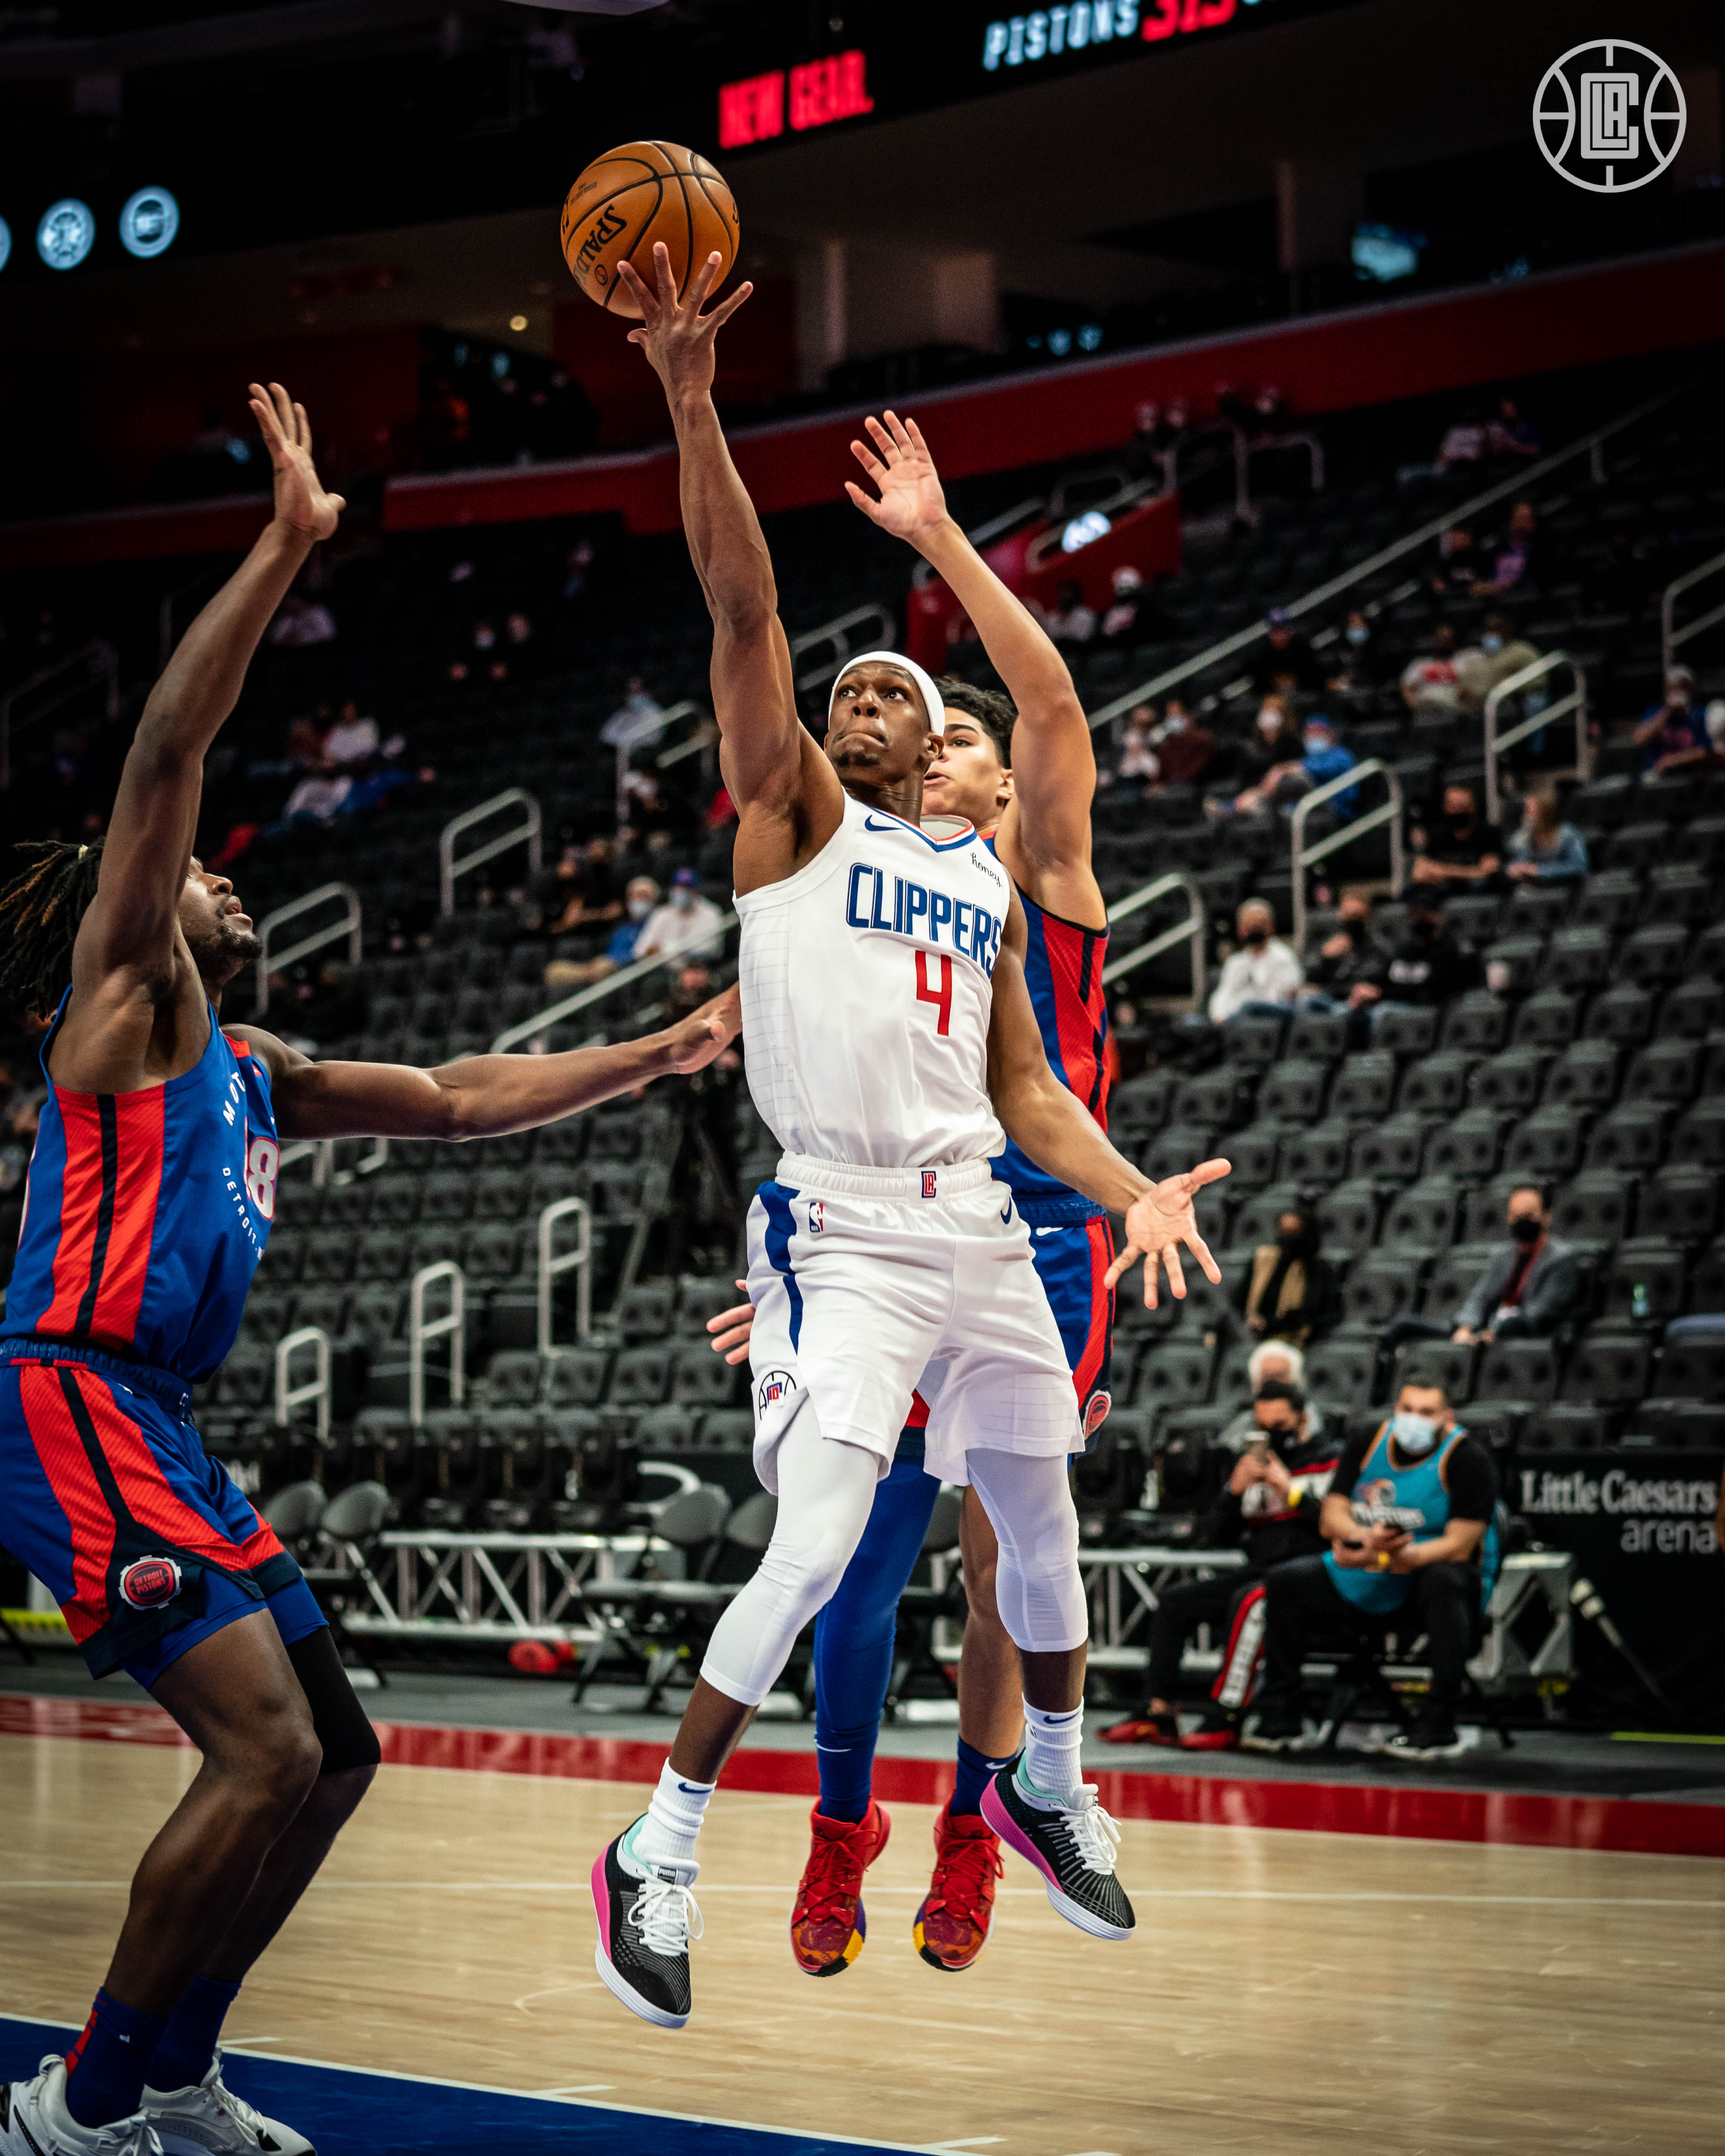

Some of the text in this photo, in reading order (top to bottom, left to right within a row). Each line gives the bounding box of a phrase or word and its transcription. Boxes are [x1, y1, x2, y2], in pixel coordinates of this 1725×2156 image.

[970, 852, 1002, 887] honey
[846, 862, 1002, 980] CLIPPERS
[915, 950, 952, 1036] 4
[223, 1167, 257, 1244] DETROIT
[1520, 1469, 1718, 1514] Little Caesars
[1621, 1519, 1718, 1553] arena
